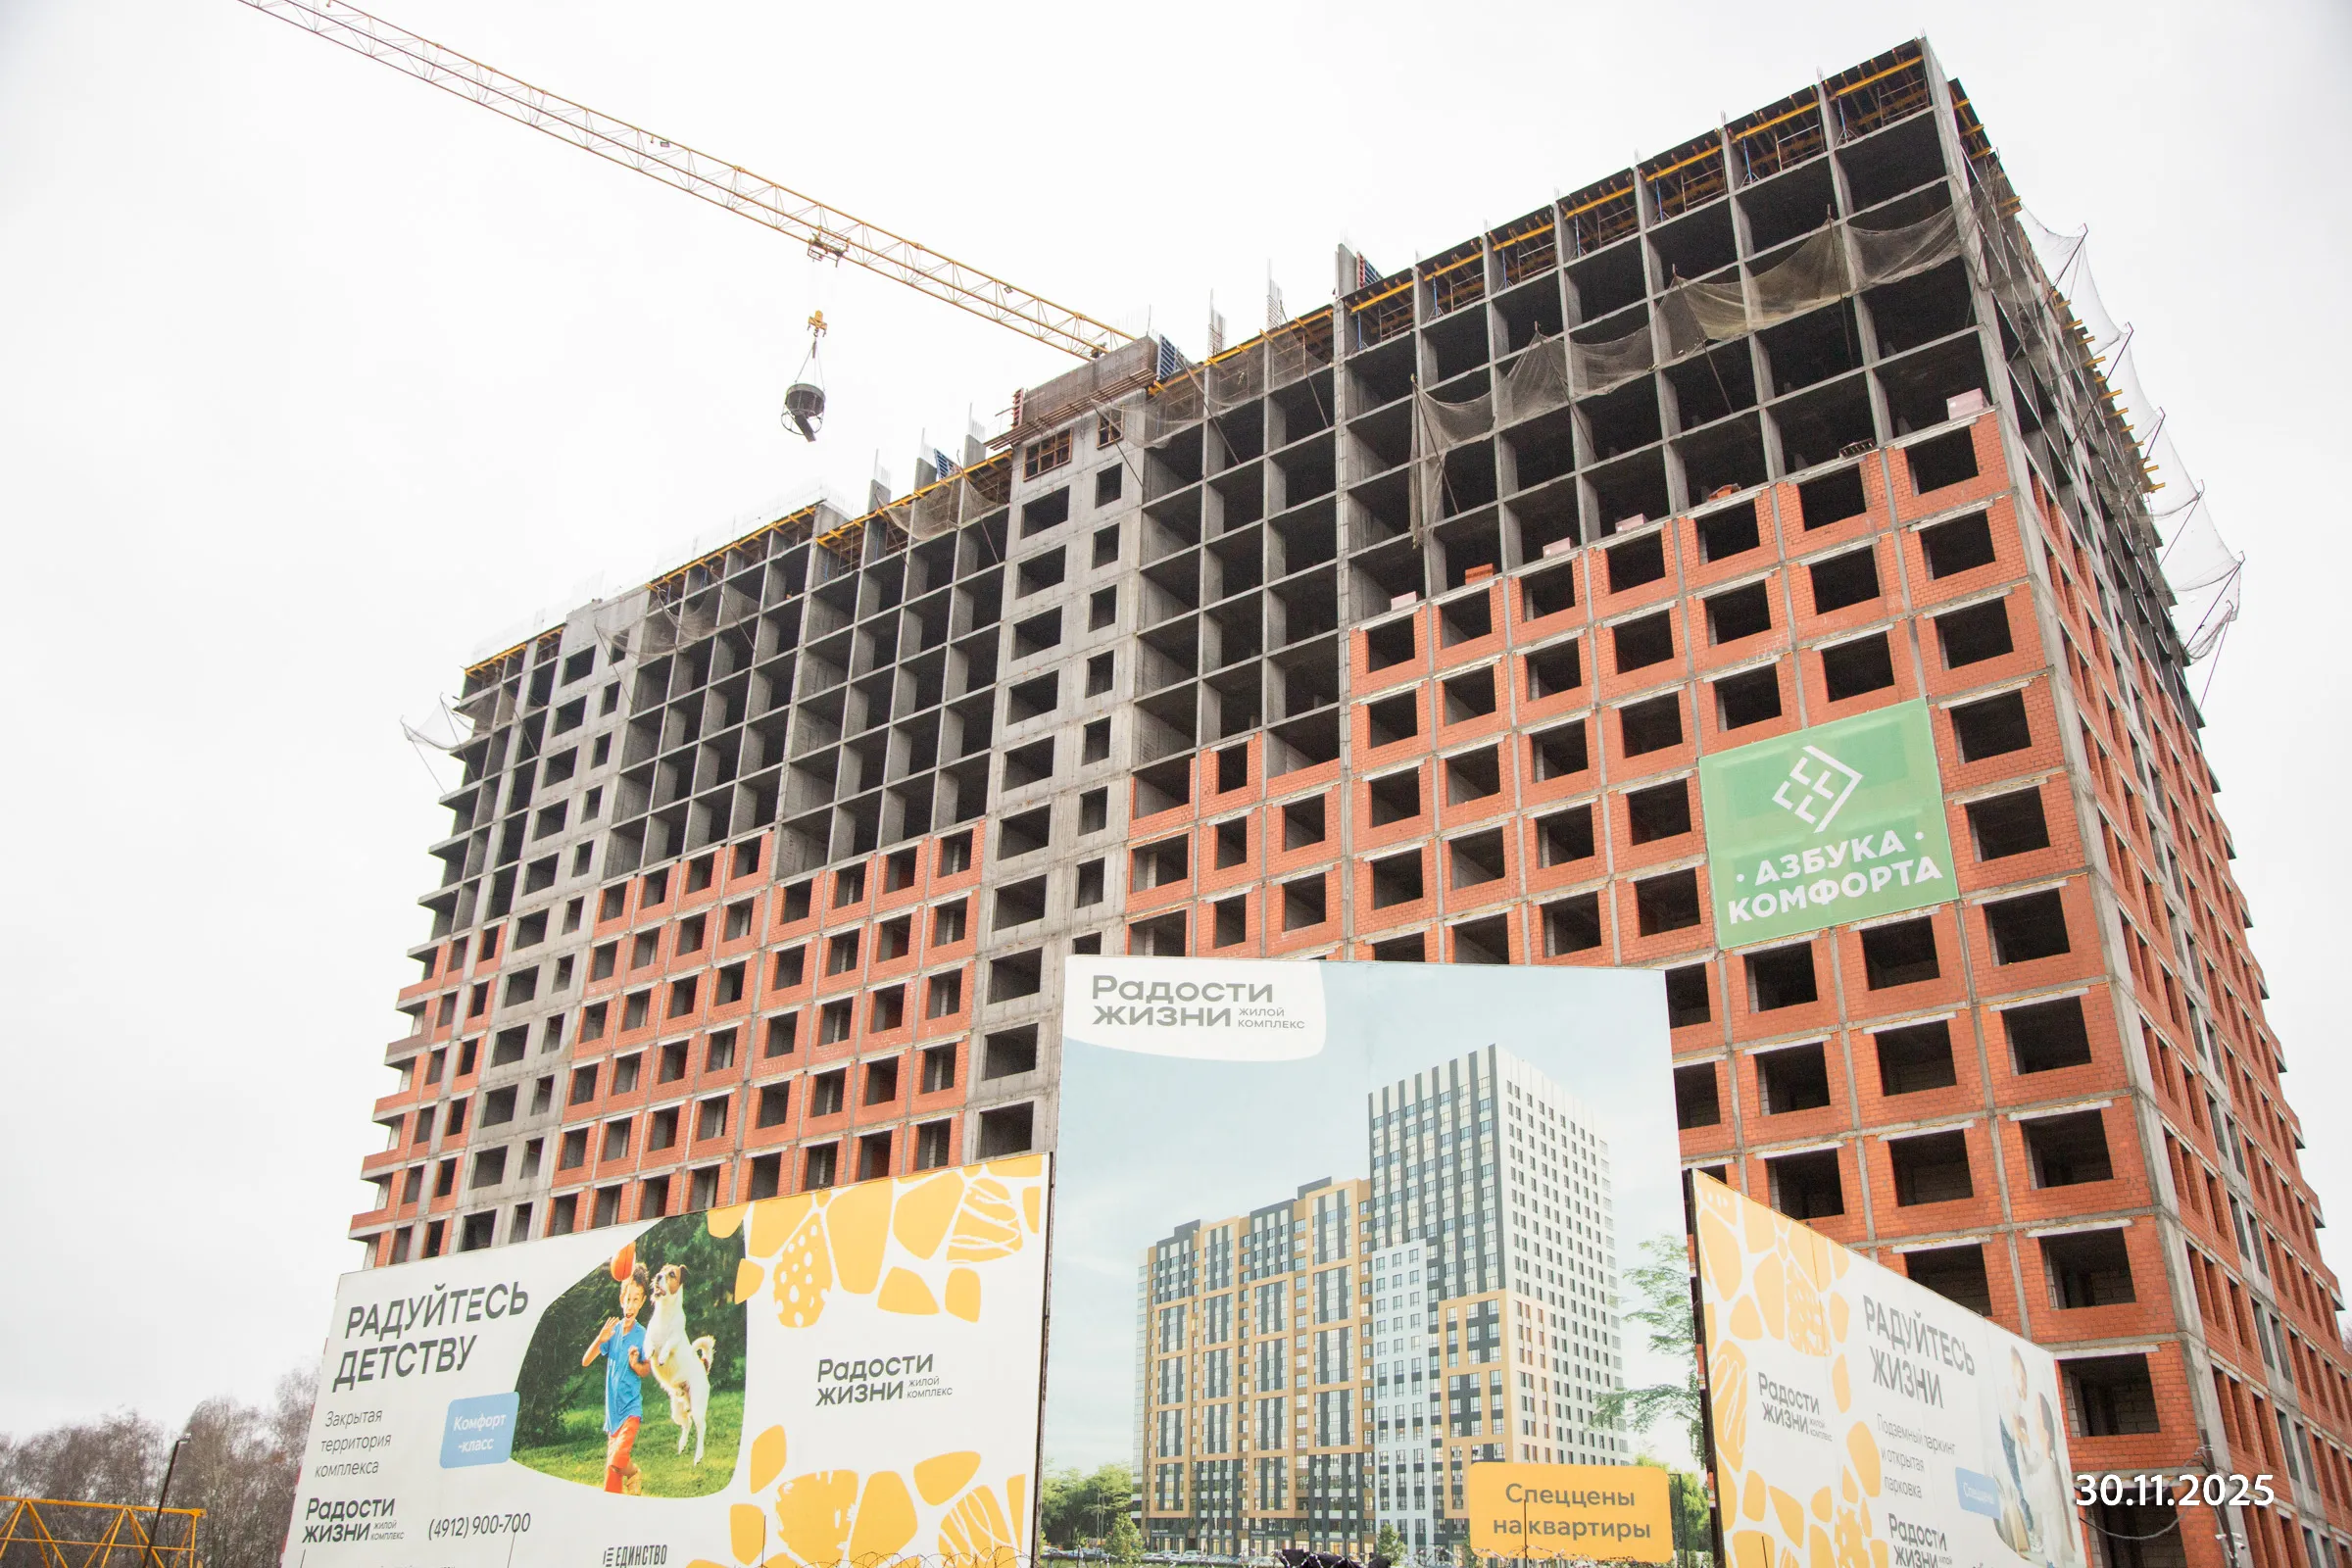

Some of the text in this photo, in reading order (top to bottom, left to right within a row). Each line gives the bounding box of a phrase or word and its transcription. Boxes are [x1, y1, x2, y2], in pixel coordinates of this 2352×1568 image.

[1754, 828, 1906, 887] АЗБУКА
[1728, 856, 1943, 925] КОМФОРТА
[1092, 974, 1273, 1004] Радости
[345, 1281, 529, 1342] РАДУЙТЕСЬ
[1863, 1295, 1975, 1376] РАДУЙТЕСЬ
[332, 1334, 478, 1393] ДЕТСТВУ
[817, 1353, 934, 1383] Радости
[1869, 1346, 1944, 1409] ЖИЗНИ
[1758, 1372, 1820, 1415] Радости
[325, 1410, 382, 1429] Закрытая
[453, 1413, 507, 1432] Комфорт
[1877, 1413, 1923, 1446] Подземный
[321, 1435, 392, 1454] территория
[458, 1438, 494, 1453] -класс
[315, 1461, 379, 1478] комплекса
[1887, 1449, 1925, 1473] открытая
[1505, 1483, 1636, 1508] Спеццены
[1885, 1476, 1923, 1499] парковка
[306, 1497, 395, 1522] Радости
[428, 1512, 531, 1541] (4912) 900-700
[1494, 1519, 1651, 1542] на квартиры
[1888, 1512, 1947, 1551] Радости
[615, 1544, 667, 1568] ЕДИНСТВО
